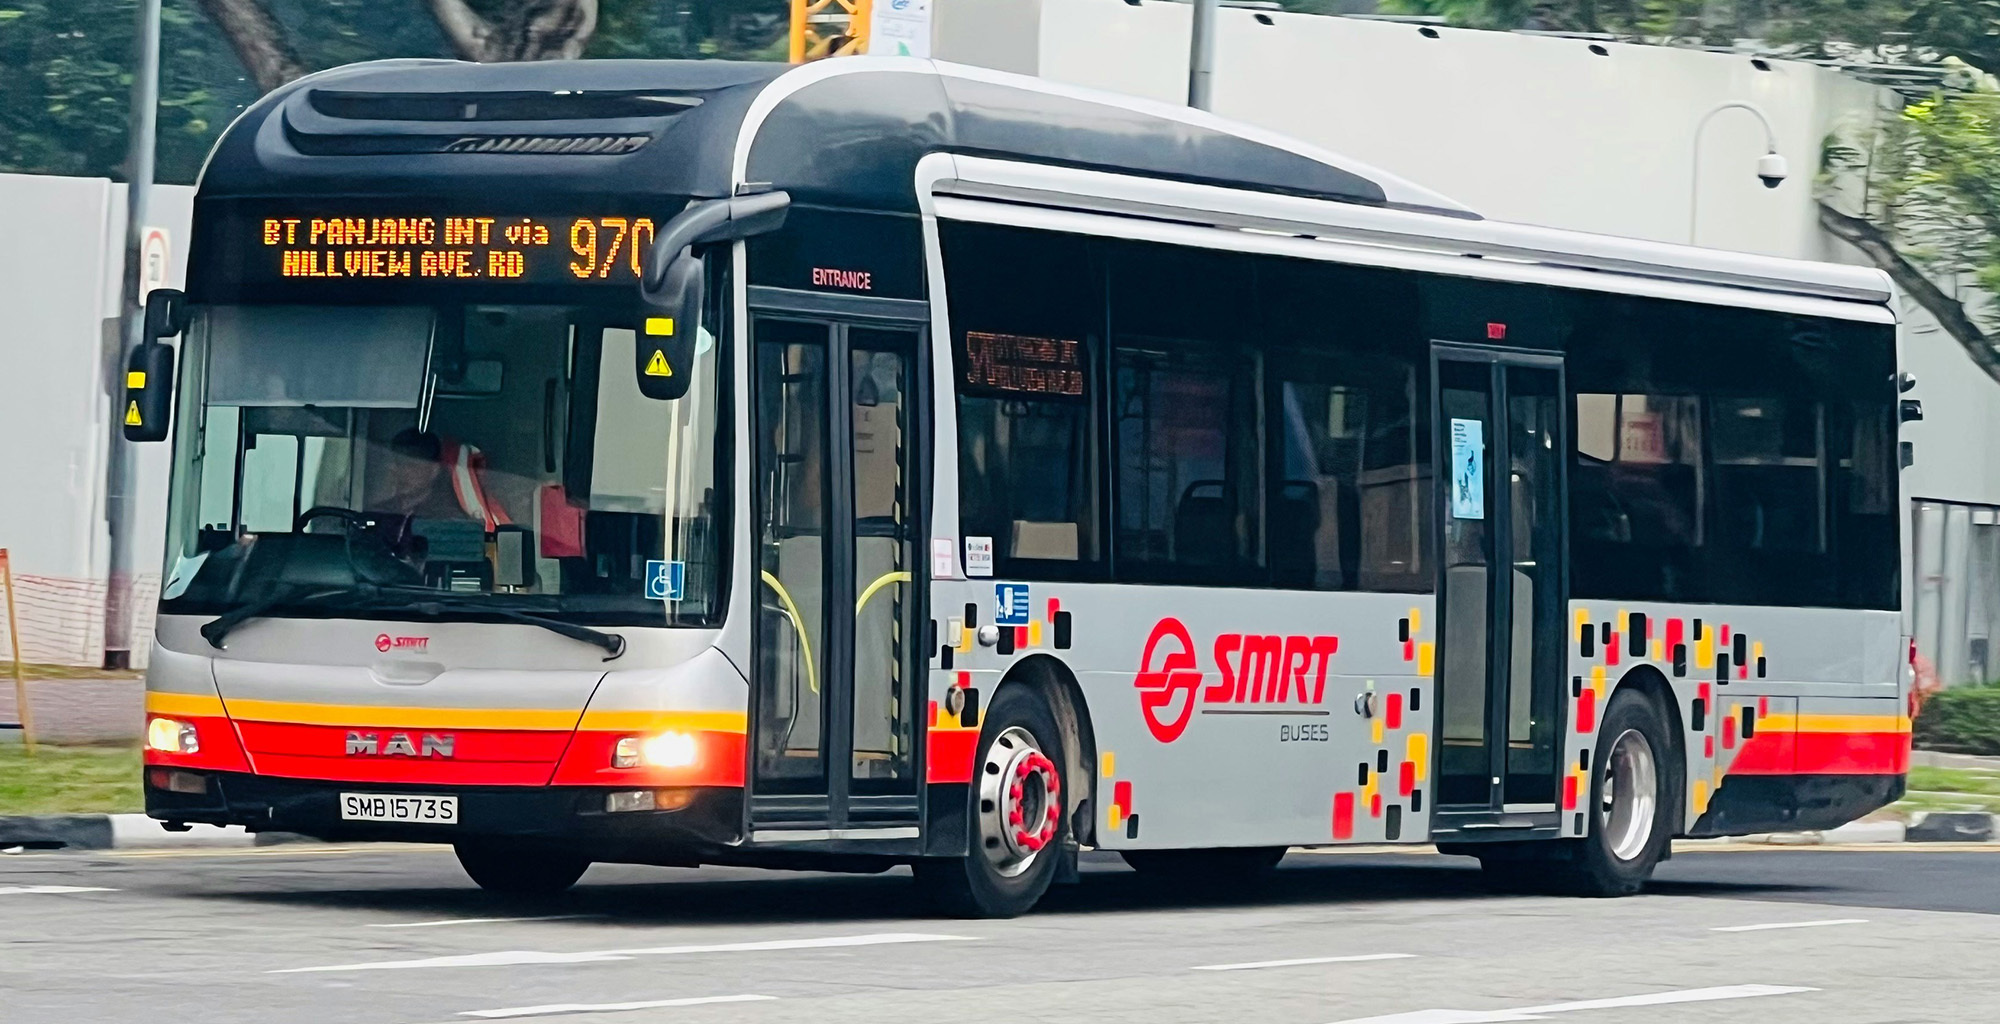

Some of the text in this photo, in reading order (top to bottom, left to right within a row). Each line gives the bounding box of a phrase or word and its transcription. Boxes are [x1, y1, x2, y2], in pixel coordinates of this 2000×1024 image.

[264, 218, 548, 245] BT PANJANG INT via
[283, 250, 412, 277] HILLVIEW
[489, 250, 524, 277] RD
[812, 267, 872, 290] ENTRANCE
[1203, 634, 1339, 704] SMRT
[345, 730, 455, 757] MAN
[1280, 724, 1329, 742] BUSES
